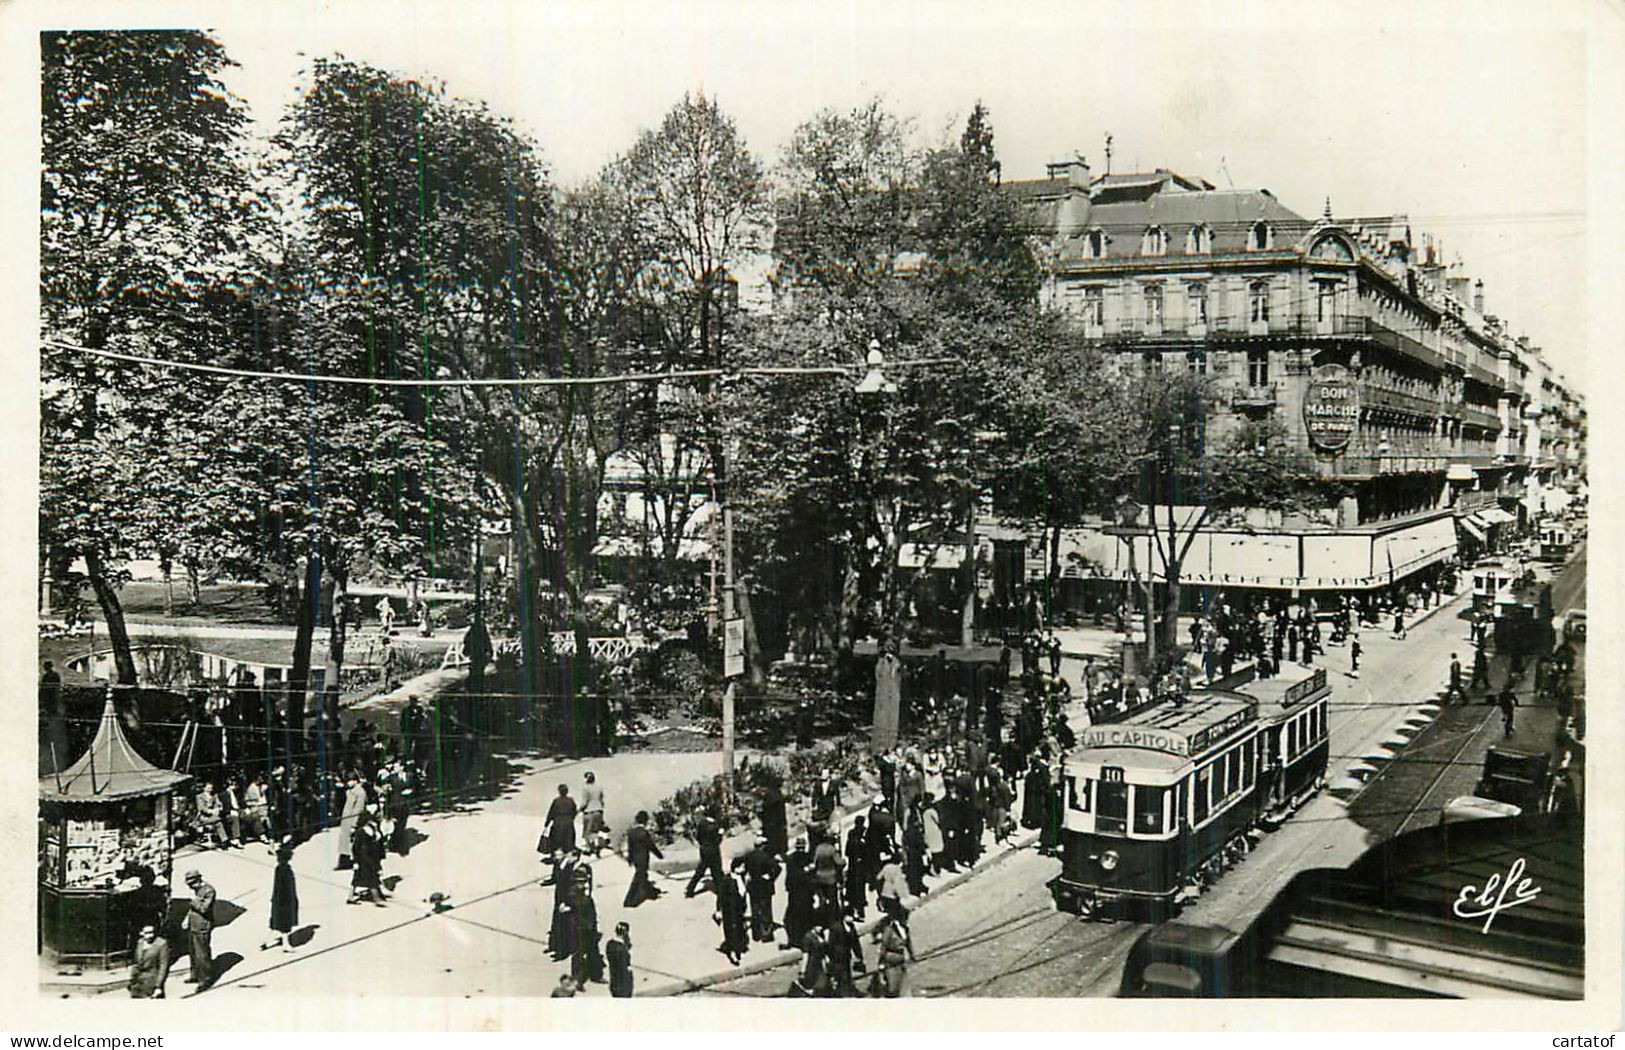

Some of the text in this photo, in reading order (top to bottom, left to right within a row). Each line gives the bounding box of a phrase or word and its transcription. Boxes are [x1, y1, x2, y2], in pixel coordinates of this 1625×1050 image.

[1321, 387, 1348, 399] BON
[1111, 731, 1186, 752] CAPITOLE
[1105, 768, 1121, 782] 10
